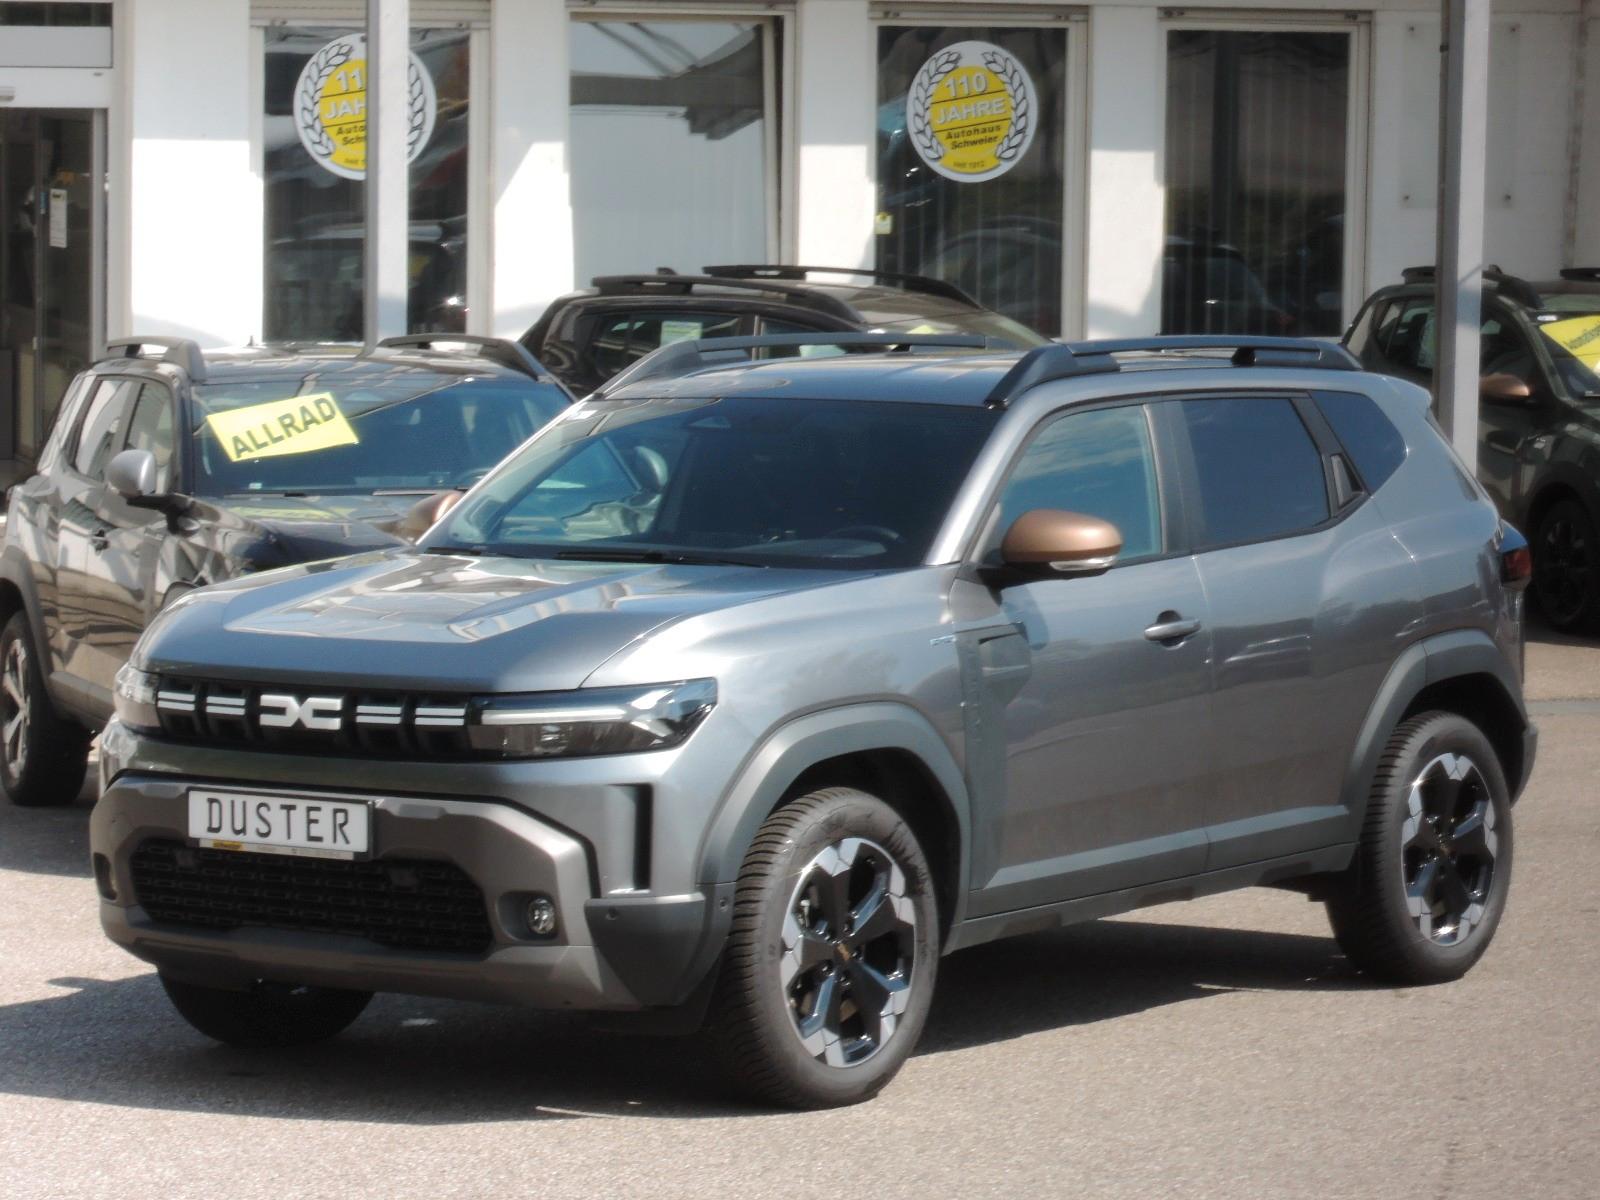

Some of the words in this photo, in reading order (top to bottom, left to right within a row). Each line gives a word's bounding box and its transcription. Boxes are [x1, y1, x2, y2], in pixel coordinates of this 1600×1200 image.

[336, 68, 364, 92] 11
[945, 73, 988, 98] 110
[324, 98, 366, 119] JAH
[937, 97, 1008, 124] JAHRE
[336, 124, 366, 136] Auto
[945, 124, 1001, 140] Autohaus
[232, 397, 336, 458] ALLRAD
[207, 797, 350, 845] DUSTER
